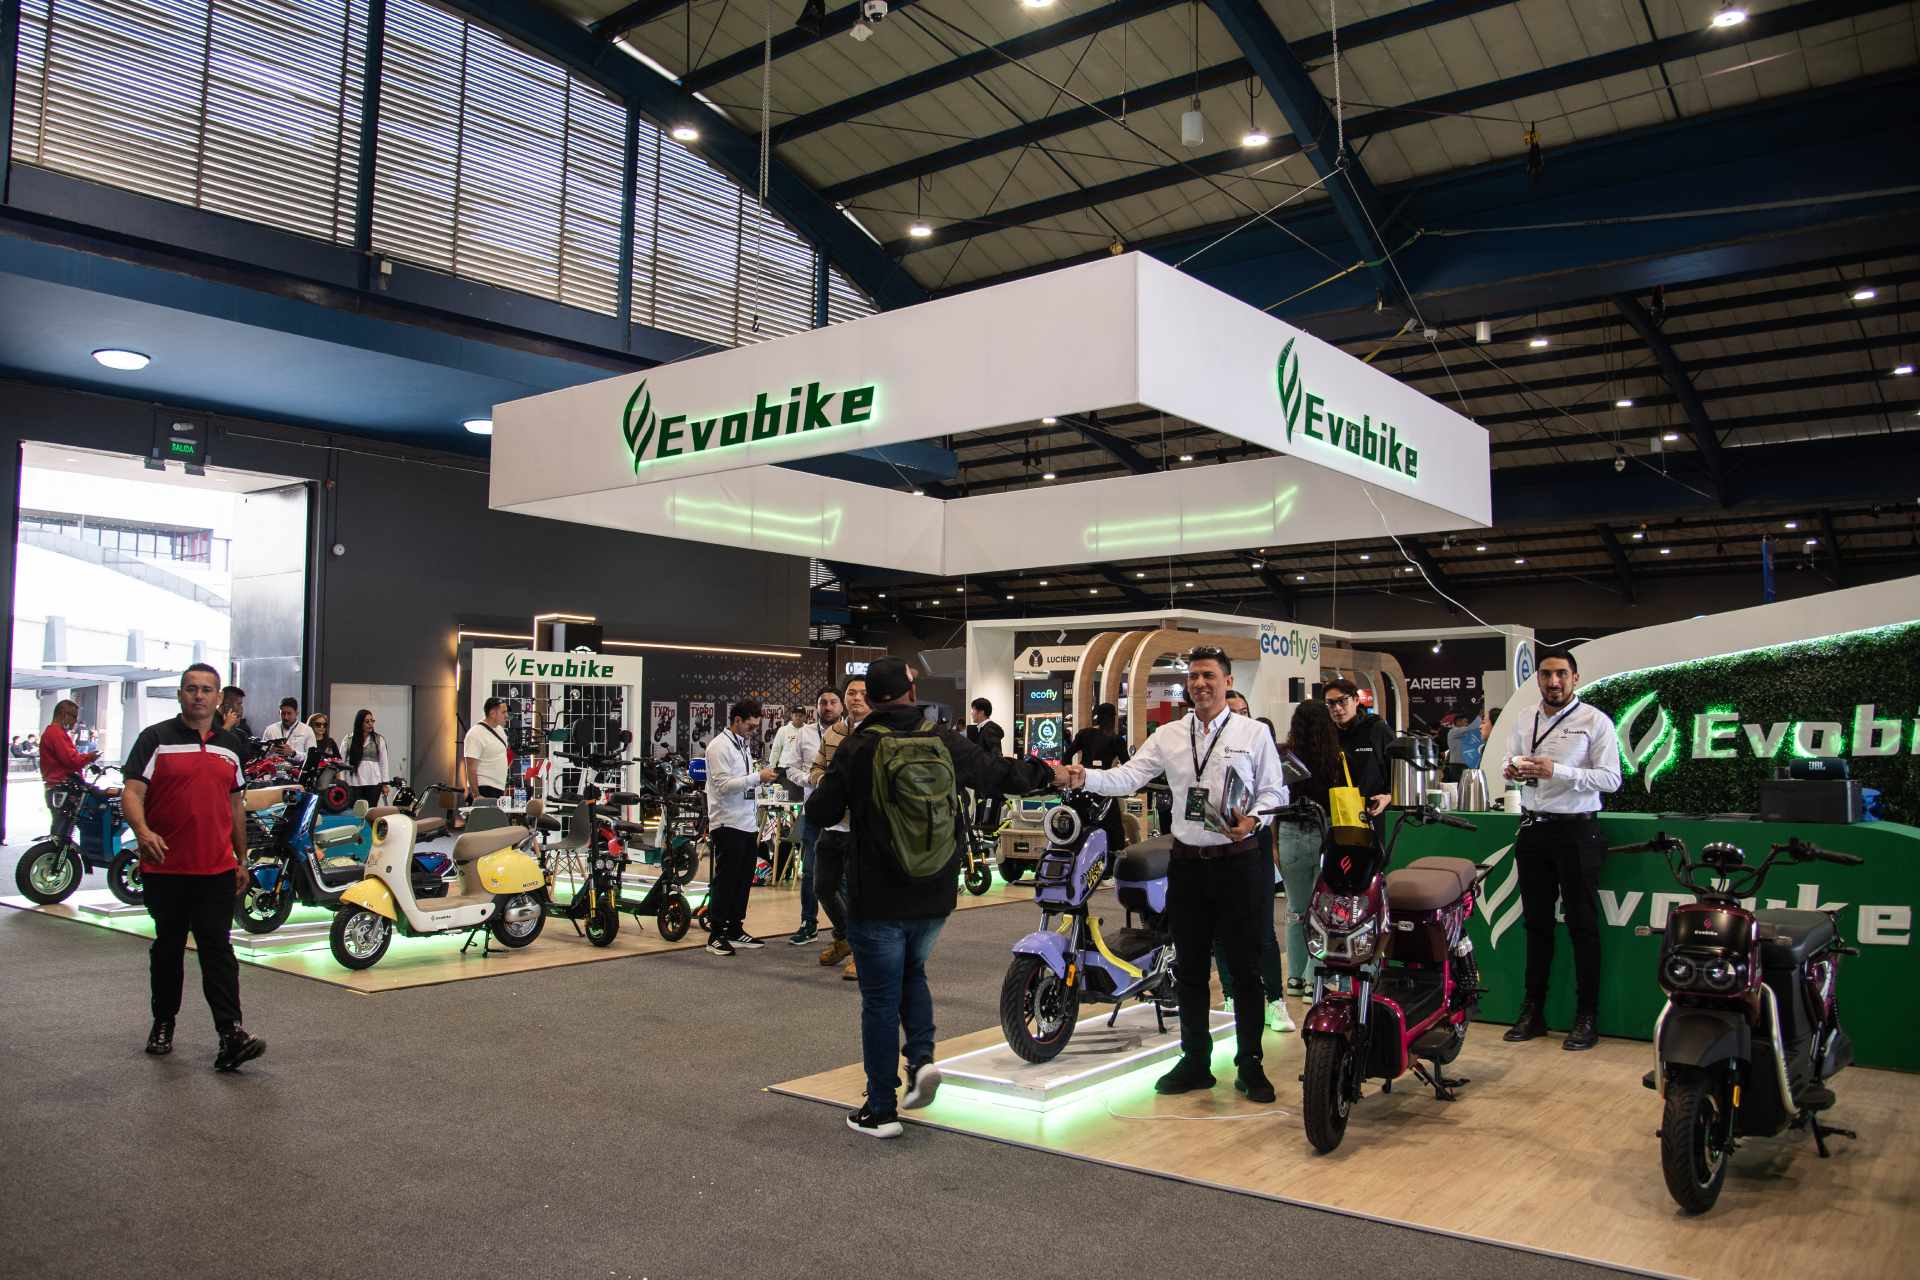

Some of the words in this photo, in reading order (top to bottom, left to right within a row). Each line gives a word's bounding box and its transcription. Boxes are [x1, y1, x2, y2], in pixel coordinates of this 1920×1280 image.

[656, 381, 876, 460] Evobike
[1304, 392, 1418, 479] Evobike
[171, 443, 194, 454] SALIDA
[1260, 629, 1309, 665] ecofly
[520, 658, 614, 678] Evobike
[1465, 676, 1476, 689] 3
[1030, 689, 1058, 702] ecofly
[1808, 761, 1826, 771] JBL
